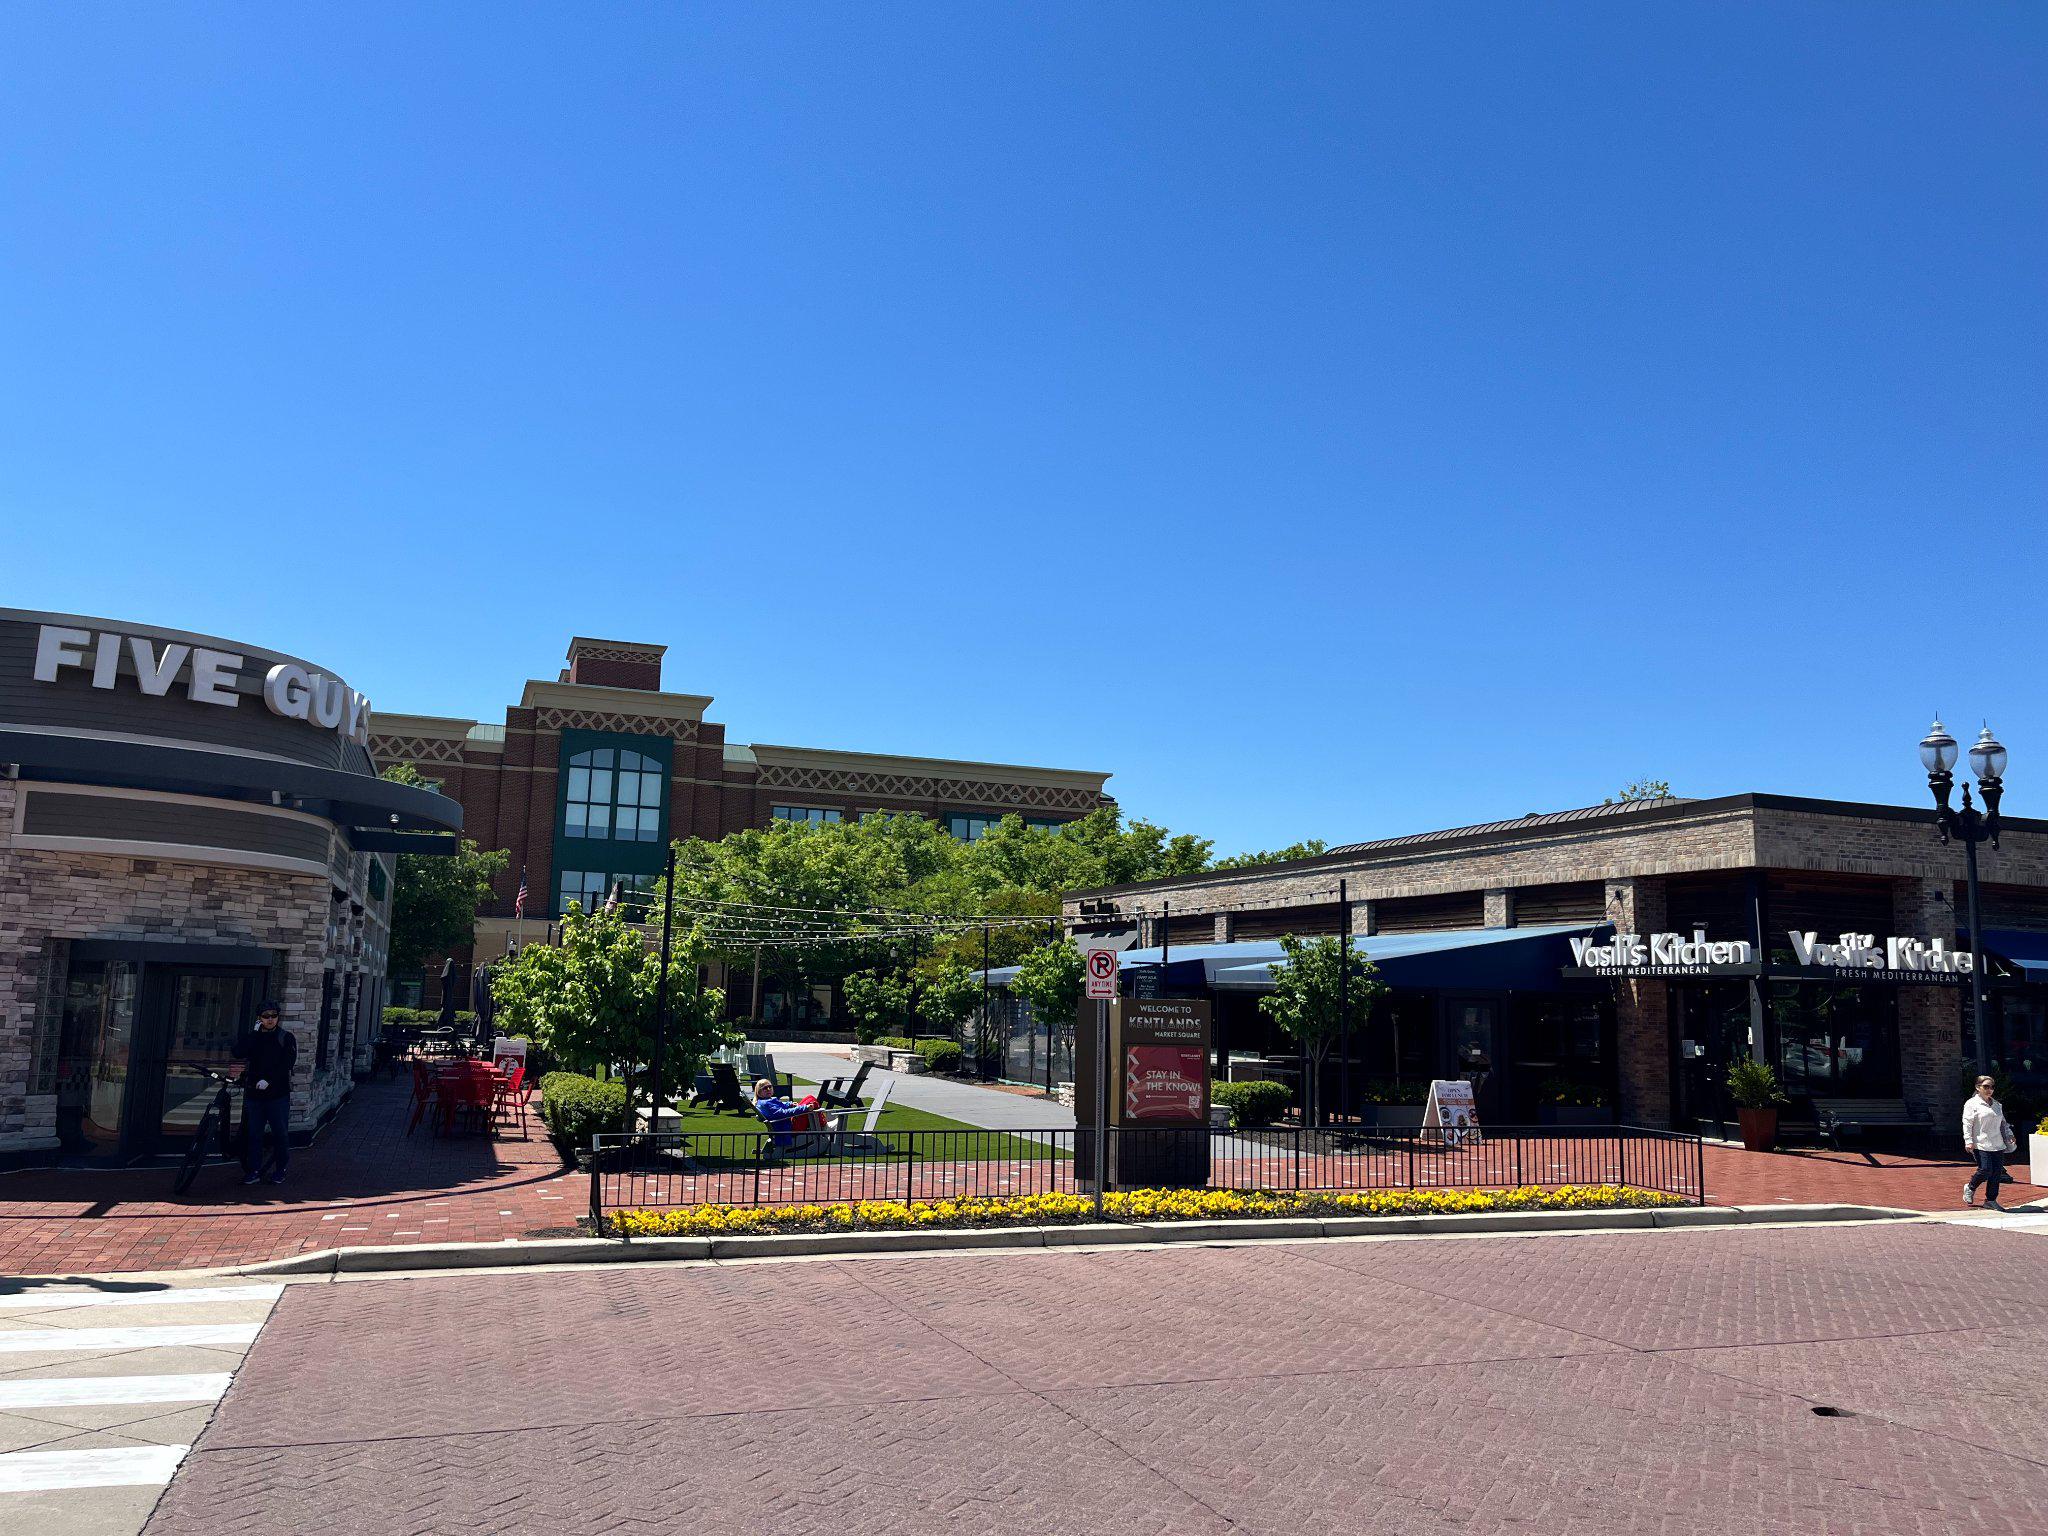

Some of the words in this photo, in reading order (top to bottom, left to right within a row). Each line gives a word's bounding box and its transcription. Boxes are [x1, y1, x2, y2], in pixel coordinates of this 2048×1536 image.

[33, 625, 245, 708] FIVE
[263, 664, 372, 748] GUYS
[1568, 934, 1650, 969] Vasili's
[1650, 930, 1751, 966] Kitchen
[1787, 930, 1885, 970] Vasili's
[1596, 967, 1623, 976] FRESH
[1627, 965, 1710, 976] MEDITERRANEAN
[1835, 968, 1867, 979] FRESH
[1872, 972, 1959, 984] MEDITERRANEAN
[1139, 1004, 1179, 1014] WELCOME
[1181, 1006, 1192, 1014] TO
[1128, 1016, 1201, 1030] KENTLANDS
[1178, 1031, 1201, 1039] SQUARE
[1937, 1029, 1953, 1042] 705
[1146, 1070, 1168, 1080] STAY
[1169, 1070, 1181, 1080] IN
[1146, 1081, 1163, 1091] THE
[1165, 1082, 1201, 1092] KNOW!
